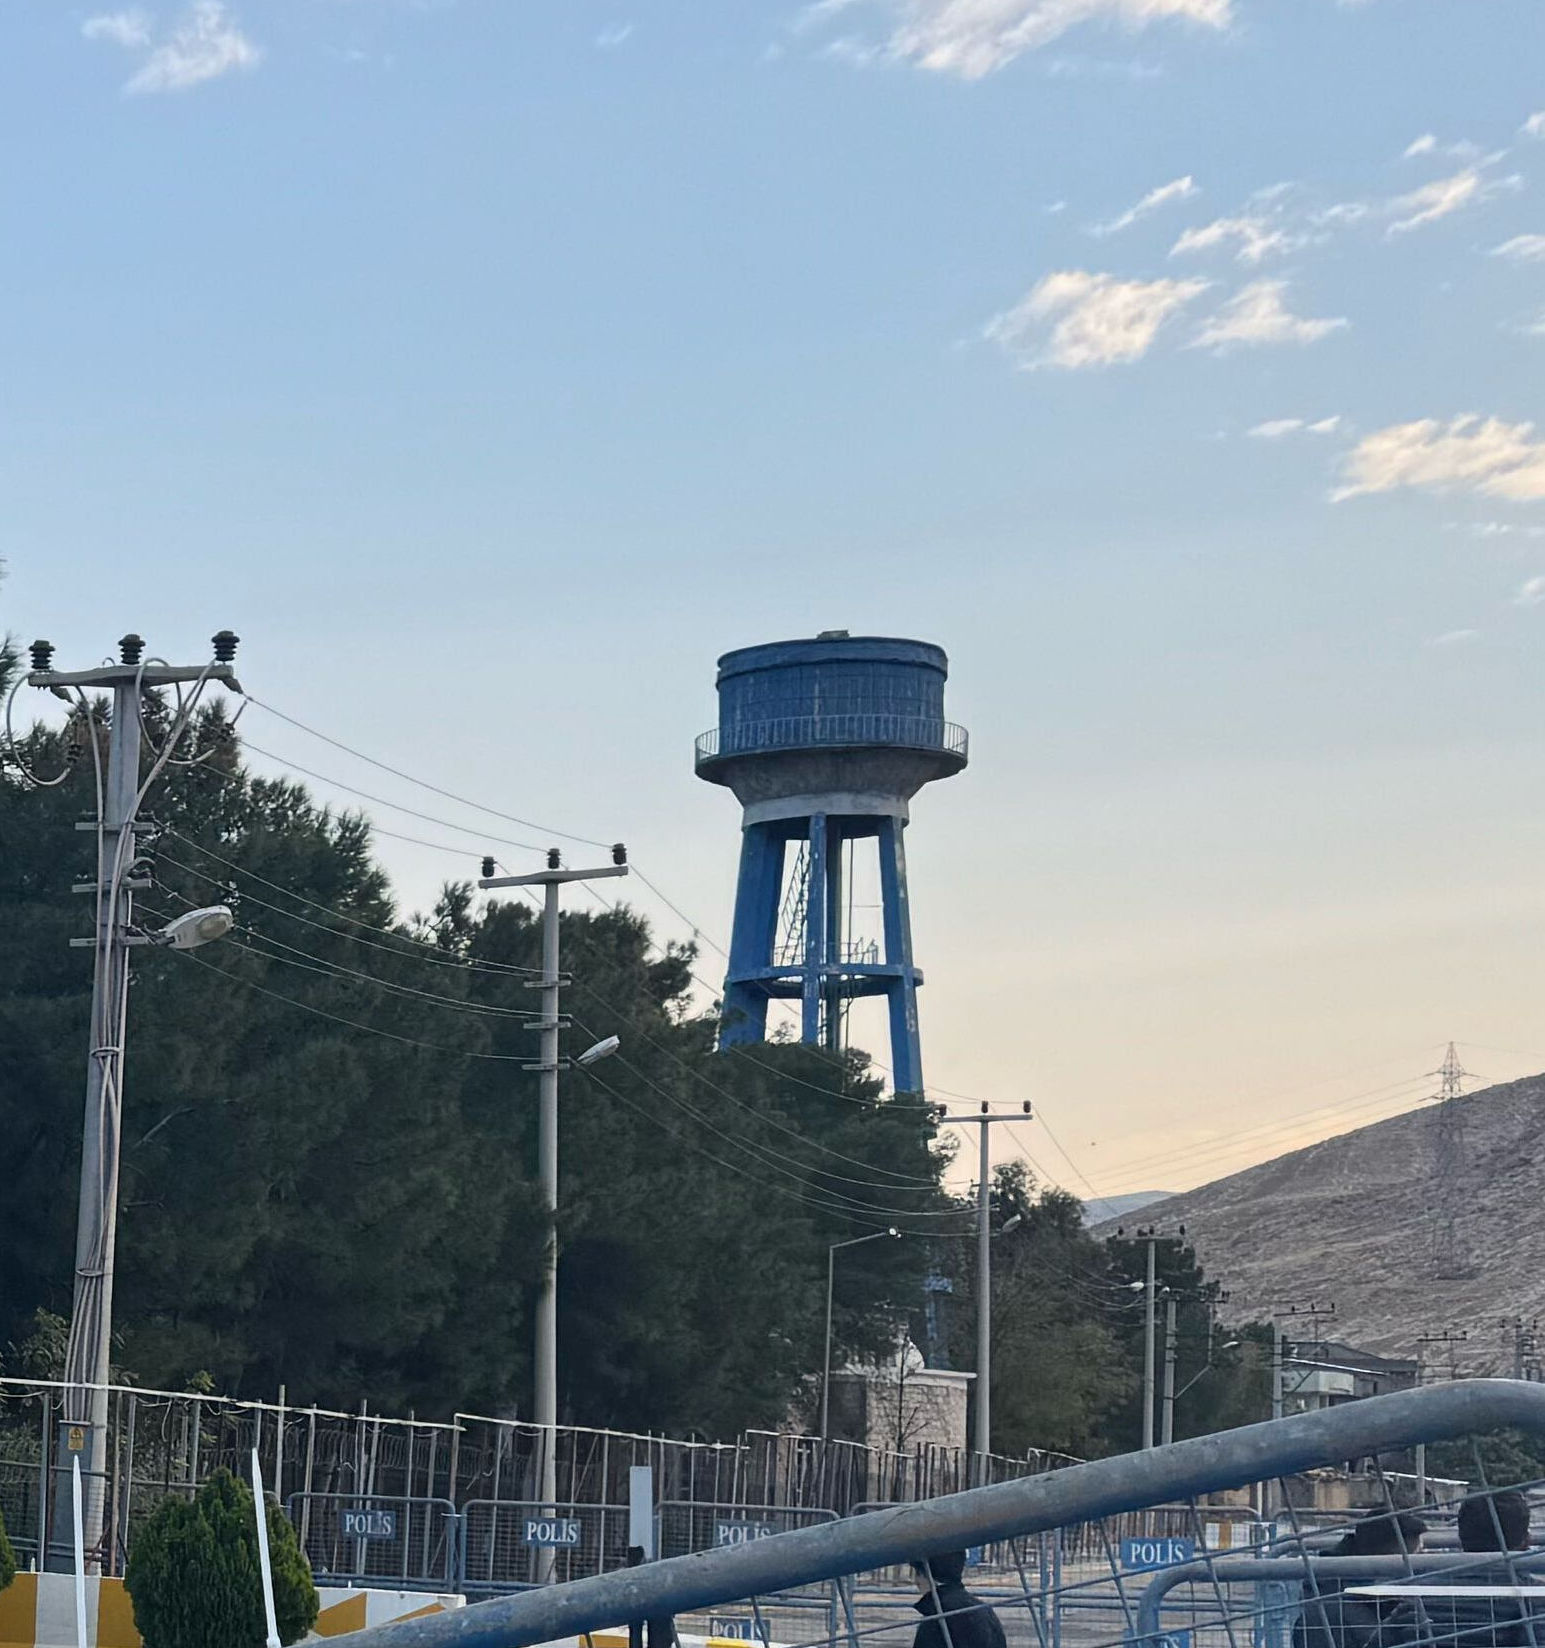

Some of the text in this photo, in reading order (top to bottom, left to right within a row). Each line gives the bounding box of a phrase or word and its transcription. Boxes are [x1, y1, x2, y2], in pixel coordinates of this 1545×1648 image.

[345, 1511, 392, 1536] POLİS
[526, 1519, 578, 1544] POLİS
[1131, 1538, 1185, 1564] POLİS
